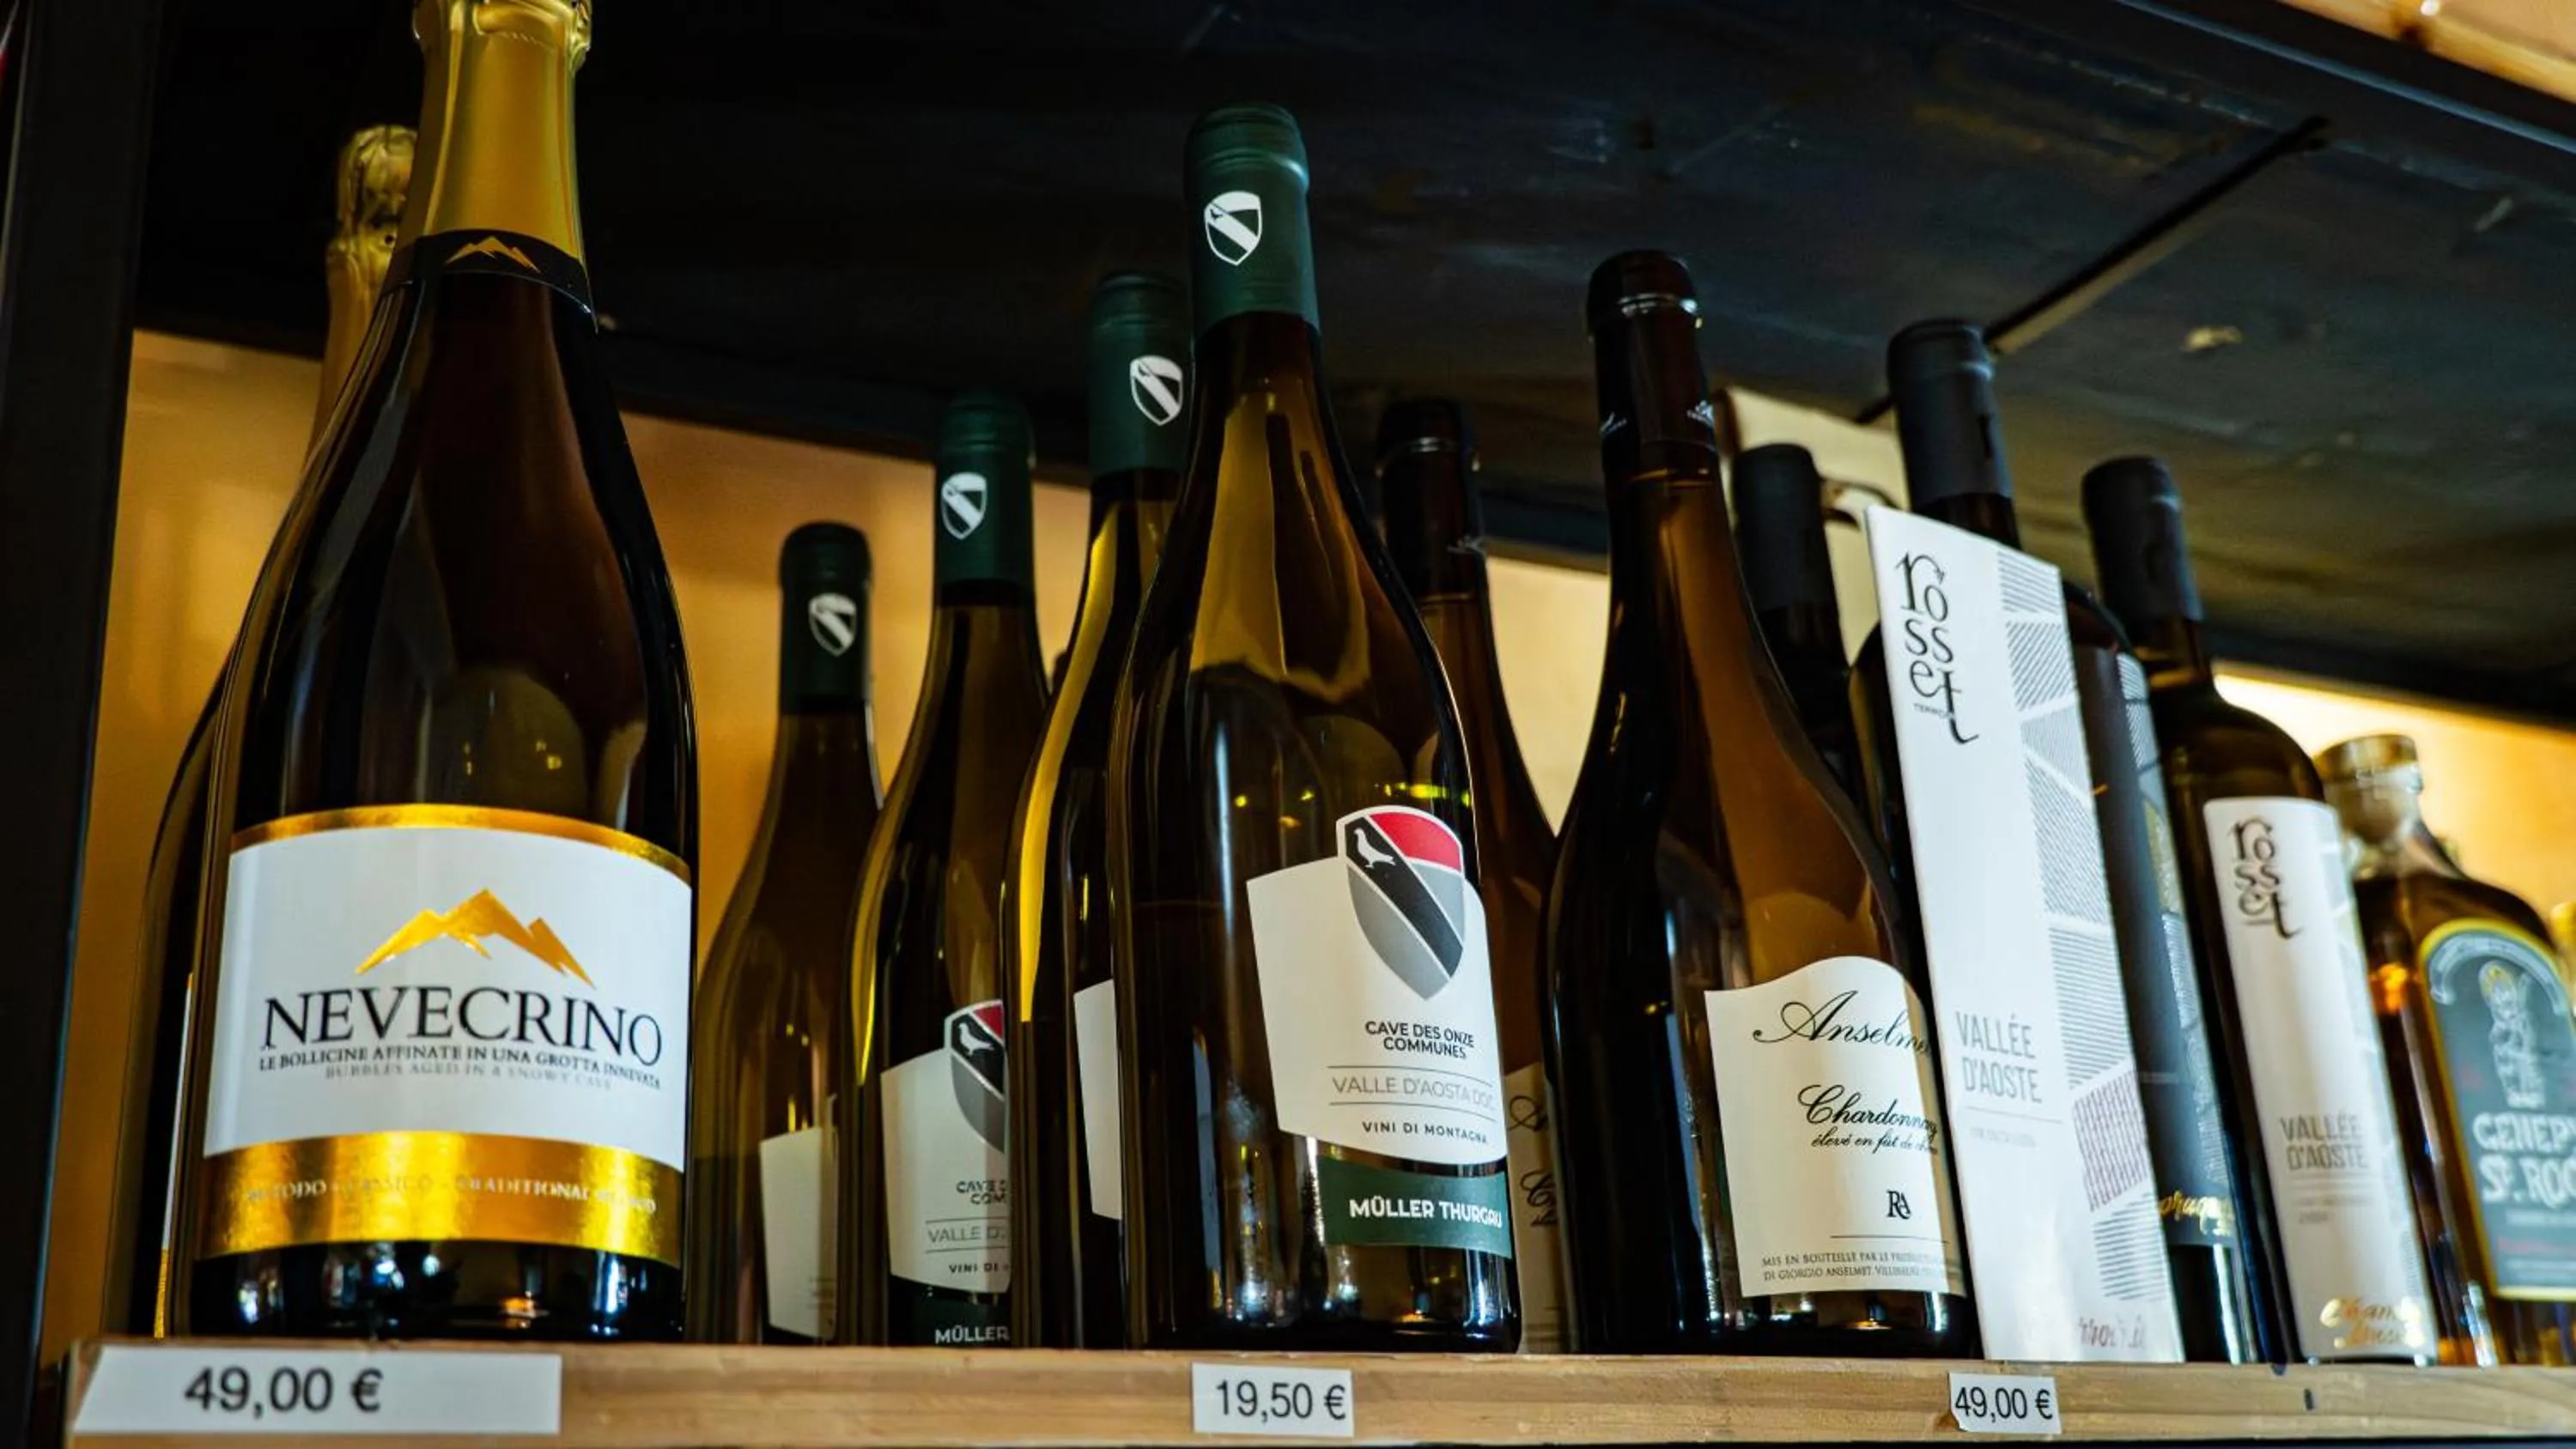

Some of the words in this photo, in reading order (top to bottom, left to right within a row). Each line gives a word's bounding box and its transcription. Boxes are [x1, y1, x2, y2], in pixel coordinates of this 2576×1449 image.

[259, 985, 661, 1066] NEVECRINO
[1364, 1021, 1408, 1036] CAVE
[1413, 1024, 1441, 1040] DES
[1444, 1028, 1474, 1048] ONZE
[1955, 1010, 2036, 1059] VALLÉE
[260, 1057, 276, 1071] LE
[280, 1046, 368, 1068] BOLLICINE
[466, 1046, 488, 1060] IN
[492, 1048, 531, 1063] UNA
[535, 1052, 600, 1073] GROTTA
[1383, 1037, 1467, 1059] COMMUNES
[1332, 1076, 1396, 1094] VALLE
[1962, 1057, 2043, 1104] D'AOSTE
[1362, 1121, 1396, 1133] VINI
[1403, 1122, 1419, 1134] DI
[1425, 1124, 1486, 1143] MONTAGNA
[1349, 1195, 1434, 1218] MÜLLER
[1439, 1201, 1502, 1228] THURGAU
[928, 1226, 981, 1243] VALLE
[184, 1366, 334, 1419] 49,00
[351, 1367, 384, 1413] €
[1216, 1379, 1313, 1423] 19,50
[1324, 1385, 1346, 1421] €
[1954, 1386, 2027, 1423] 49,00
[2035, 1389, 2053, 1420] €
